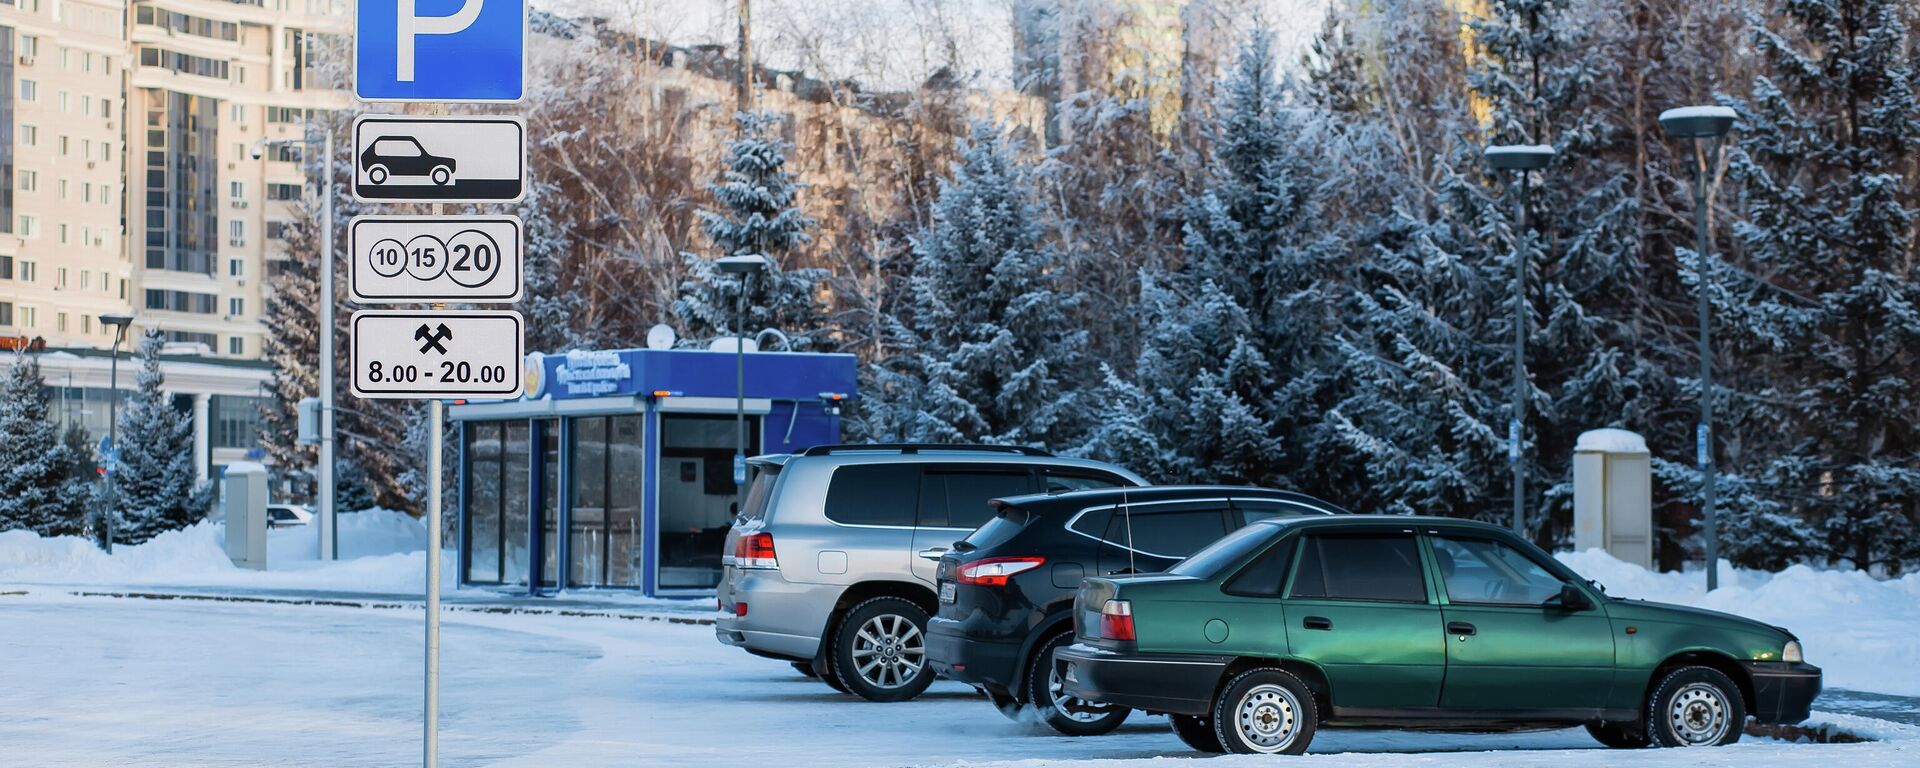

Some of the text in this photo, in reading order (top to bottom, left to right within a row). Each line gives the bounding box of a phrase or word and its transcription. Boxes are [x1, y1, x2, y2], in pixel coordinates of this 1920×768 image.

[396, 0, 484, 82] P
[376, 243, 492, 272] 10 15 20
[368, 360, 418, 383] 8.00
[439, 360, 506, 384] 20.00
